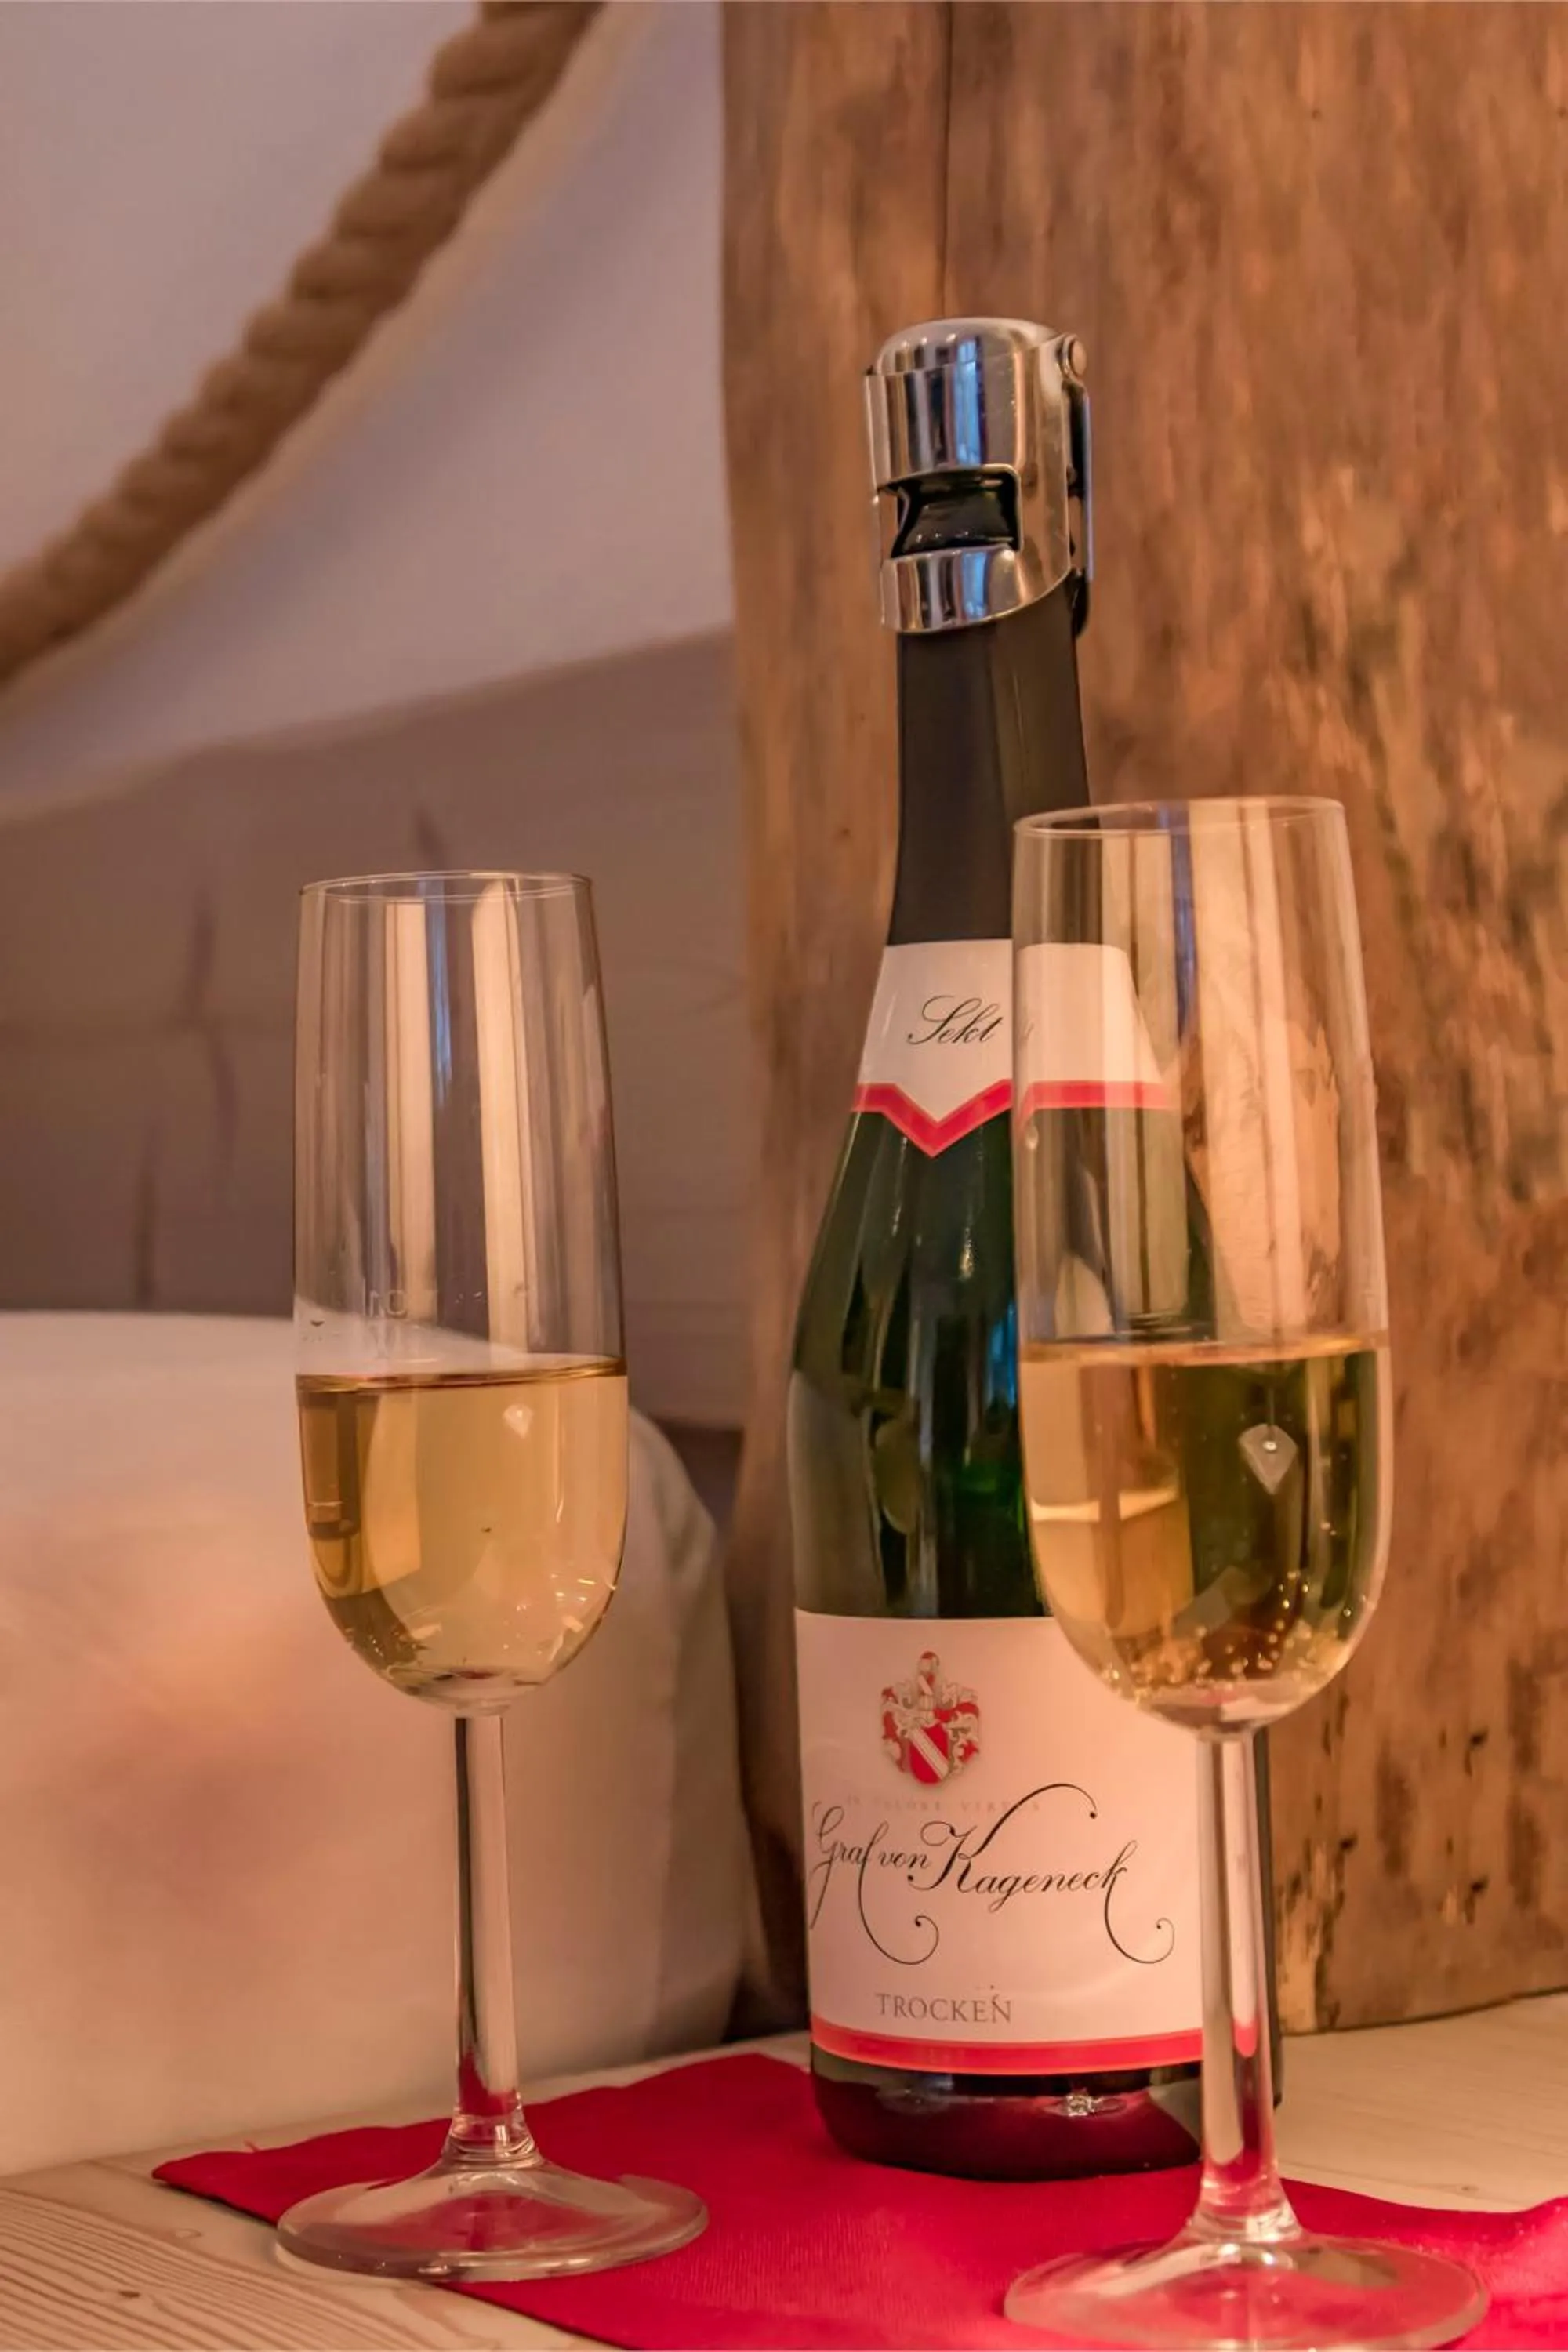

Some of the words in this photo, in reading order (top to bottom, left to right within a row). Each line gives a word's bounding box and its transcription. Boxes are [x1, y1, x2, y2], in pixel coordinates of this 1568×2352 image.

[907, 995, 1004, 1045] Sekt
[809, 1801, 939, 1965] Graf
[877, 1852, 931, 1870] von
[906, 1783, 1175, 1964] Kageneck
[874, 1992, 1012, 2023] TROCKEN
